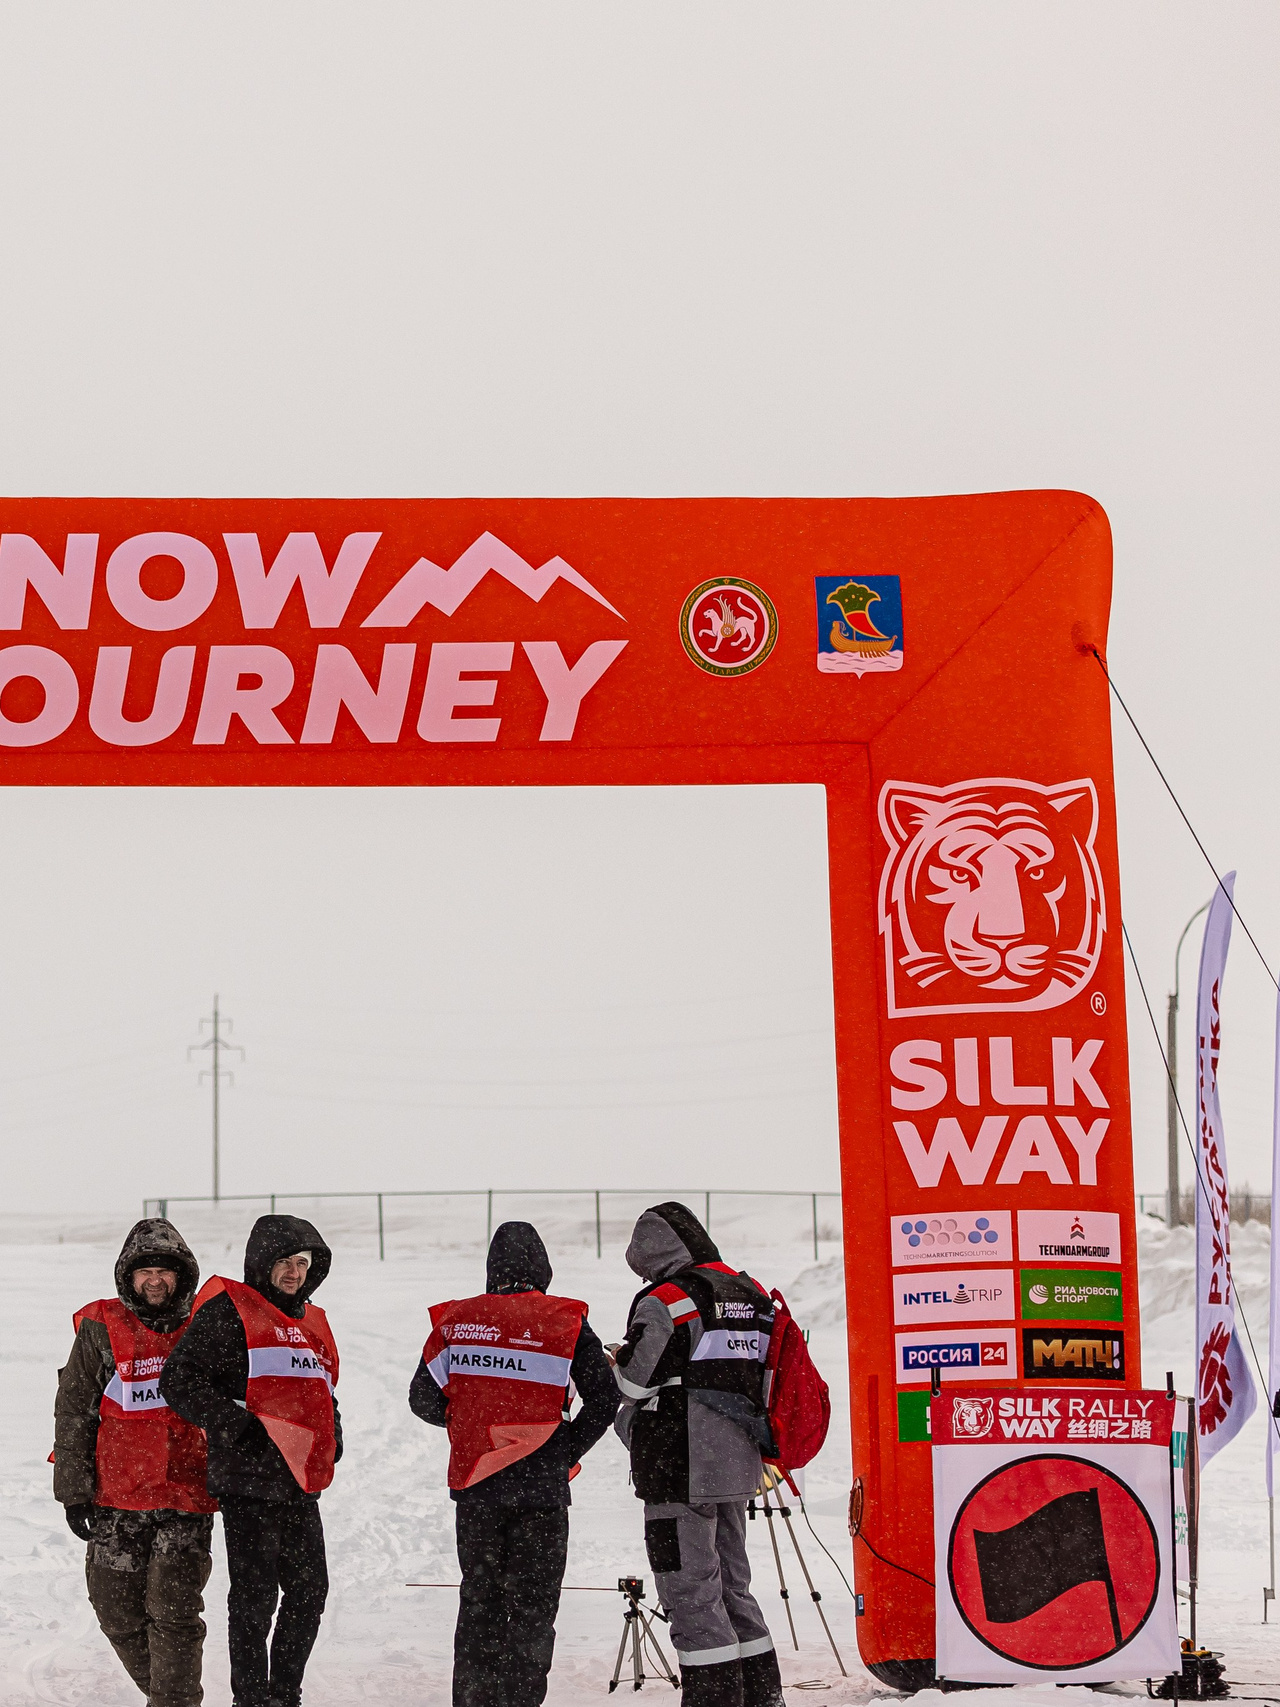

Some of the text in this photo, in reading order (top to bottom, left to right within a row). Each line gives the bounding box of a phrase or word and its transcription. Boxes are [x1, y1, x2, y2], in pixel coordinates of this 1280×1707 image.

[889, 1036, 1111, 1111] SILK
[892, 1115, 1111, 1188] WAY
[1039, 1245, 1110, 1258] TECHNOARMGROUP
[903, 1289, 1003, 1306] INTEL TRIP
[1054, 1286, 1119, 1297] РИА НОВОСТИ
[1054, 1294, 1089, 1303] СПОРТ
[724, 1302, 745, 1311] SNOW
[723, 1310, 756, 1319] JOURNEY
[454, 1324, 487, 1332] SNOW
[452, 1331, 502, 1342] JOURNEY
[727, 1339, 761, 1353] OFFIC
[134, 1356, 164, 1368] SNOW
[450, 1353, 527, 1372] MARSHAL
[908, 1347, 1005, 1365] РОССИЯ 24
[291, 1356, 323, 1371] MAR
[998, 1398, 1153, 1418] SILK RALLY
[999, 1419, 1061, 1438] WAY
[1067, 1419, 1152, 1439] 丝绸之路
